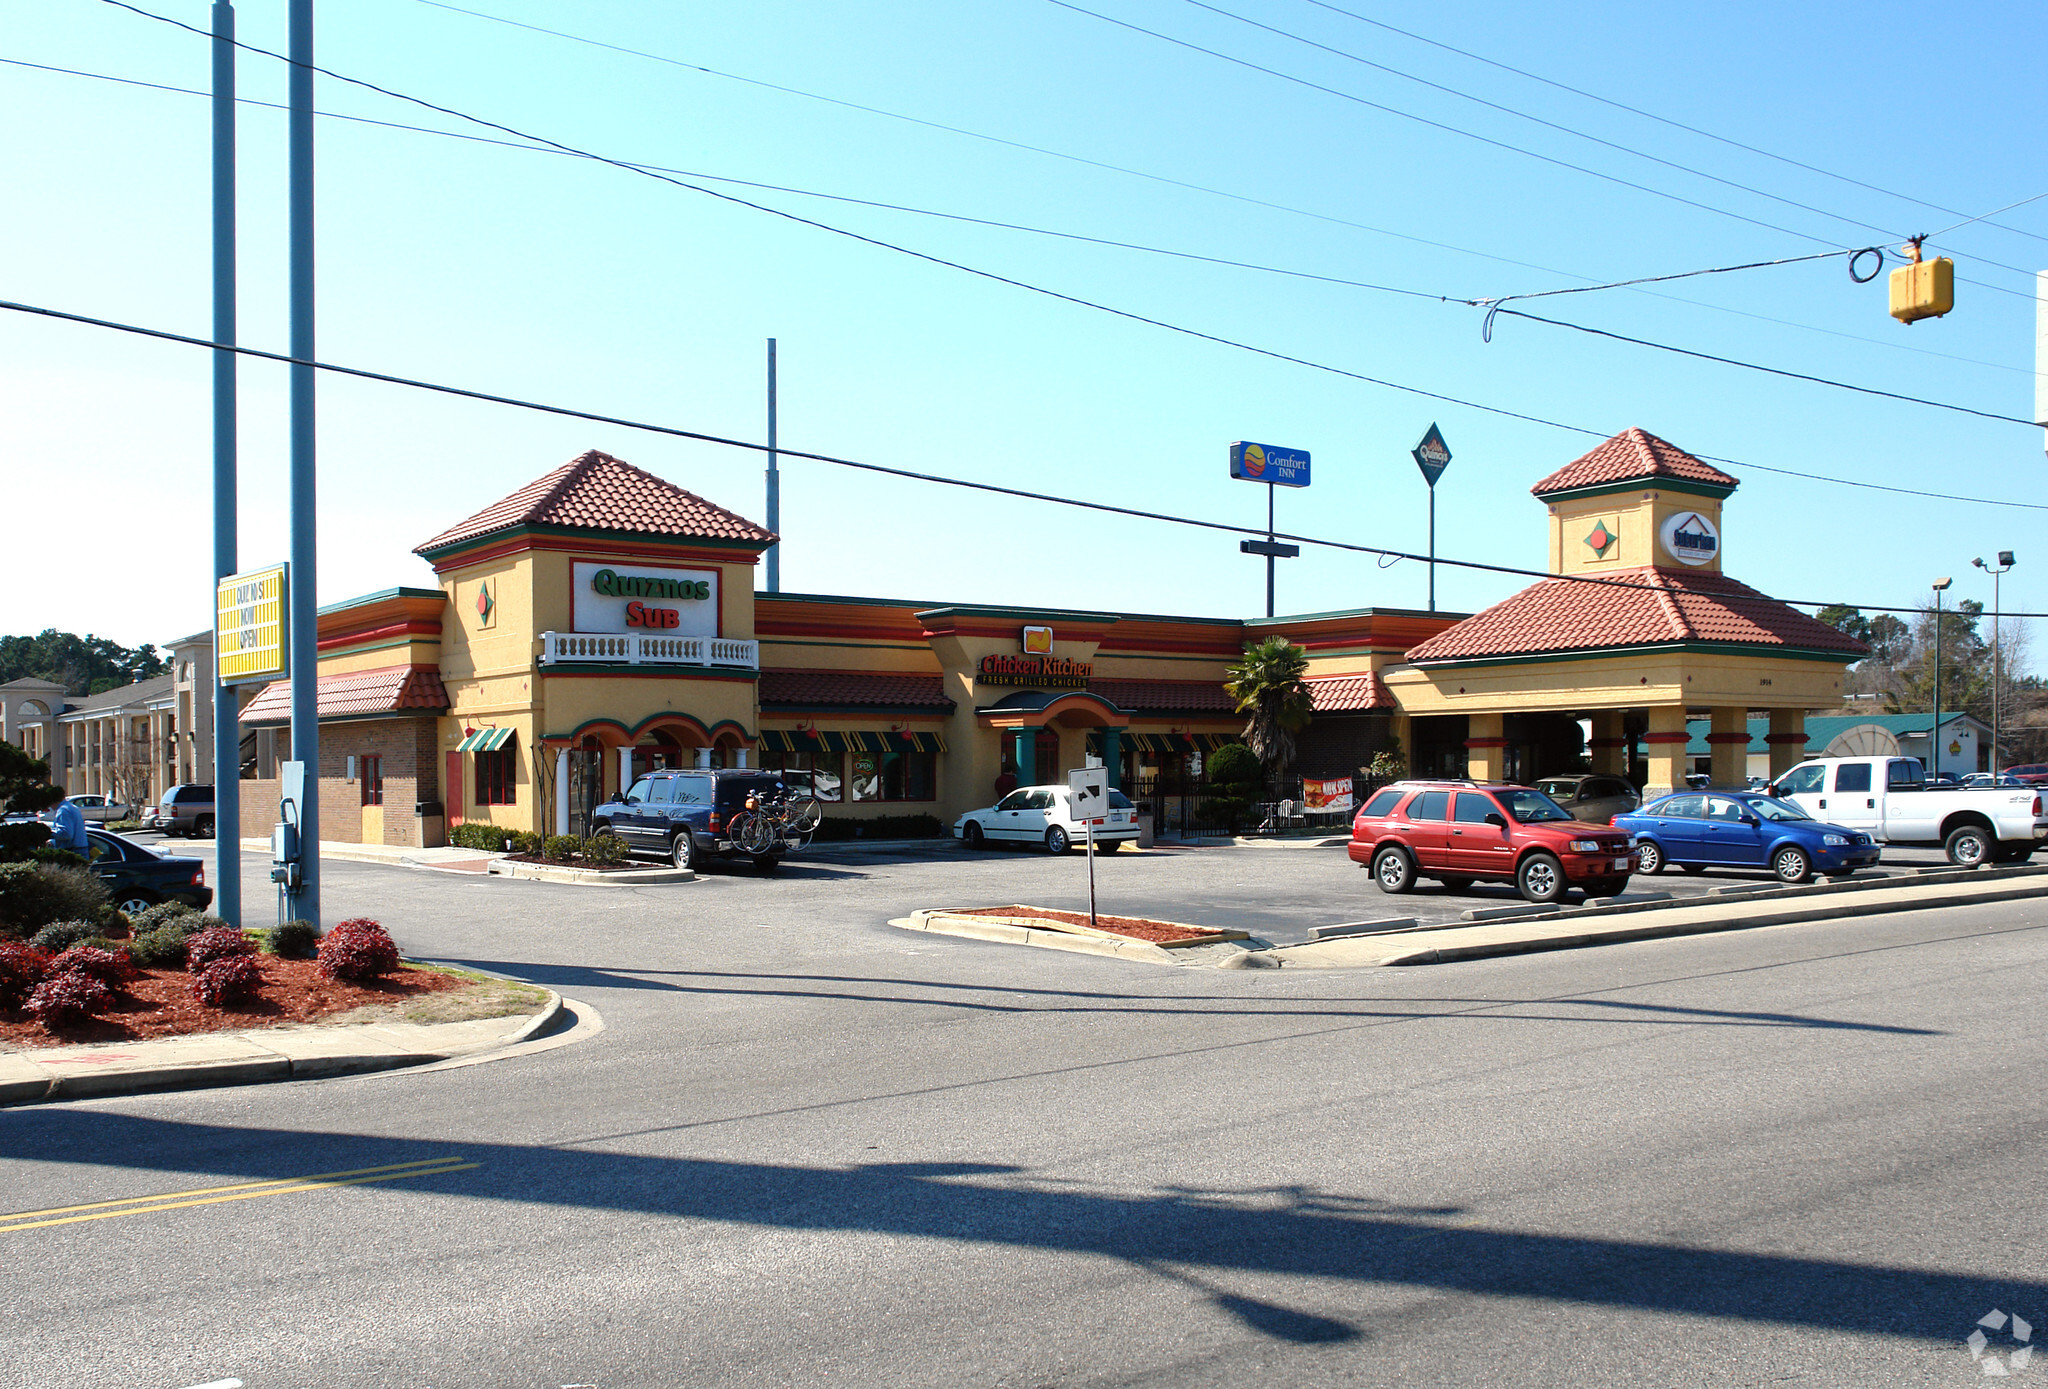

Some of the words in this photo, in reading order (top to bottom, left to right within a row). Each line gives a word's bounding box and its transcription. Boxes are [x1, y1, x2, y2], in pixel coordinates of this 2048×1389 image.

[1267, 451, 1306, 470] Comfort
[1278, 467, 1295, 479] INN
[1674, 528, 1716, 551] Suburban
[240, 605, 254, 627] NOW
[626, 601, 680, 628] SUB
[240, 628, 258, 650] OPEN
[981, 653, 1039, 675] Chicken
[1041, 656, 1094, 676] Kitchen
[981, 674, 1009, 685] FRESH
[1013, 676, 1048, 687] GRILLED
[1052, 677, 1088, 688] CHICKEN
[855, 762, 871, 770] OPEN
